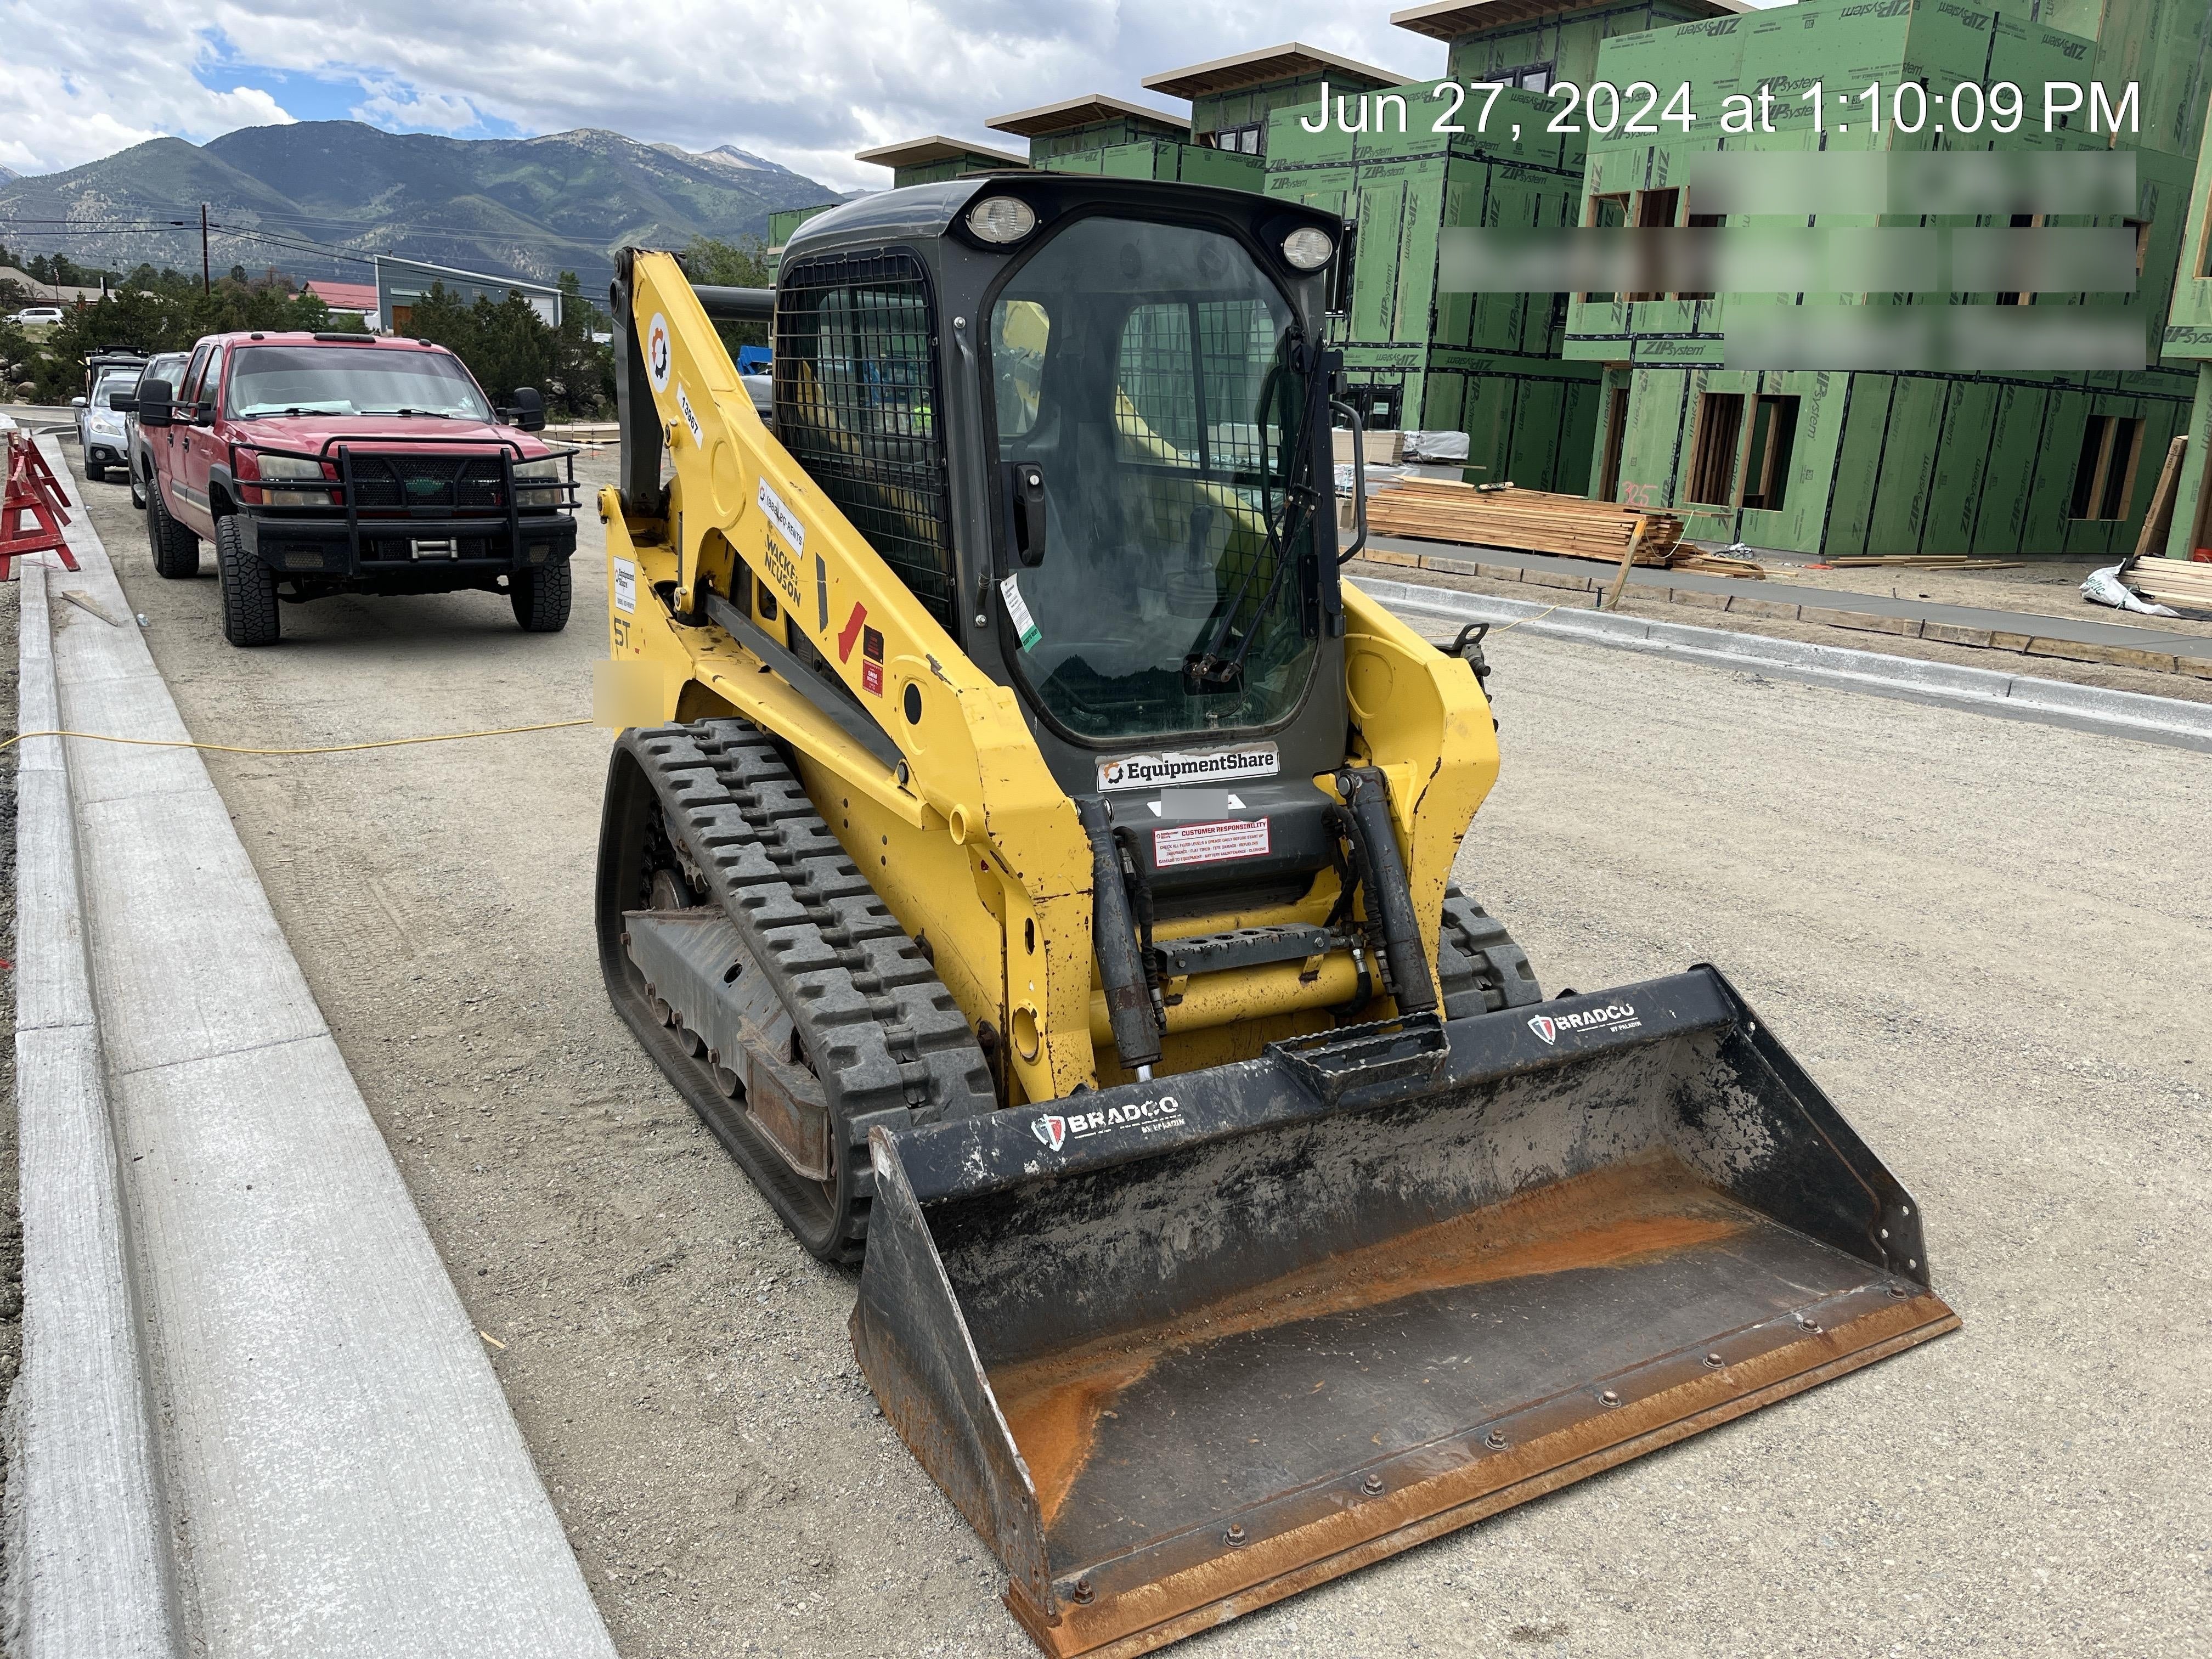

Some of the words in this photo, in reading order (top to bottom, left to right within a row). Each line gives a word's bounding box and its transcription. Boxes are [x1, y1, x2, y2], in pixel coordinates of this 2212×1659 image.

[681, 397, 699, 434] 13967
[1622, 481, 1658, 506] 325
[764, 551, 802, 608] NEUSON
[1127, 753, 1274, 782] EquipmentShare
[1182, 827, 1216, 837] CUSTOMER
[1216, 821, 1267, 832] RESPONSIBILITY
[1066, 1096, 1179, 1134] BRADCO
